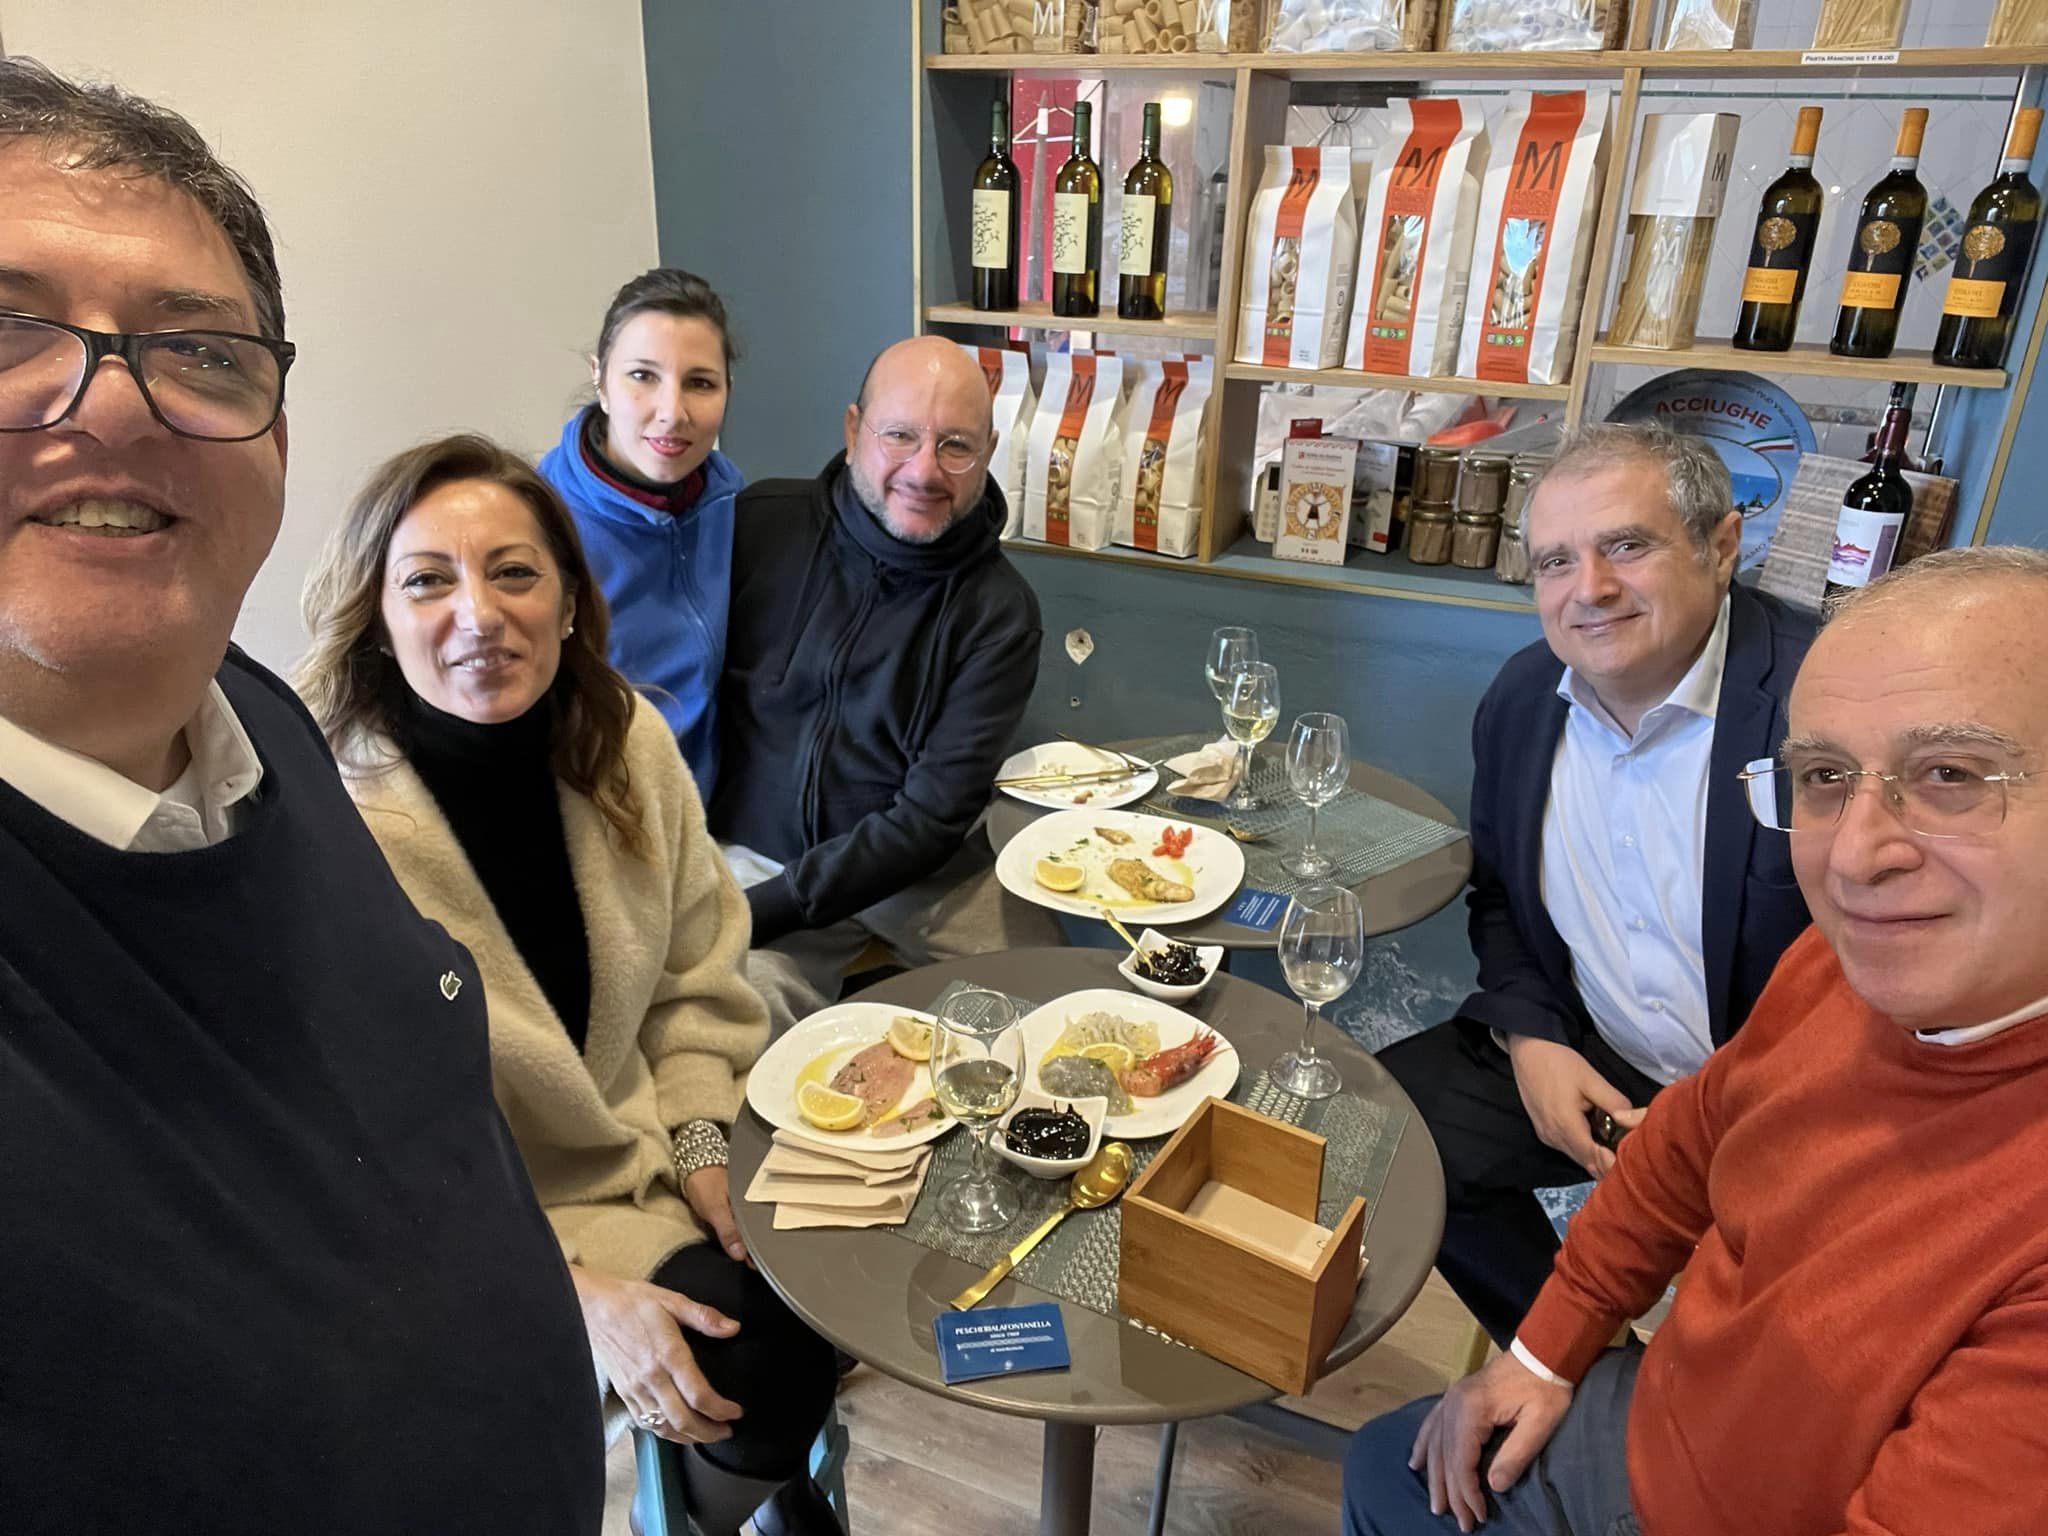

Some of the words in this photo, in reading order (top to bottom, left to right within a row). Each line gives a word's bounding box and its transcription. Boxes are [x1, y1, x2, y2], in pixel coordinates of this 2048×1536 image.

[1394, 146, 1442, 187] M
[1514, 141, 1563, 189] M
[1712, 152, 1727, 182] M
[1286, 167, 1319, 199] M
[1066, 373, 1095, 405] M
[1155, 377, 1186, 405] M
[1655, 397, 1772, 430] ACCIUGHE
[955, 1321, 1052, 1335] PESCHERIALAFONTANELLA
